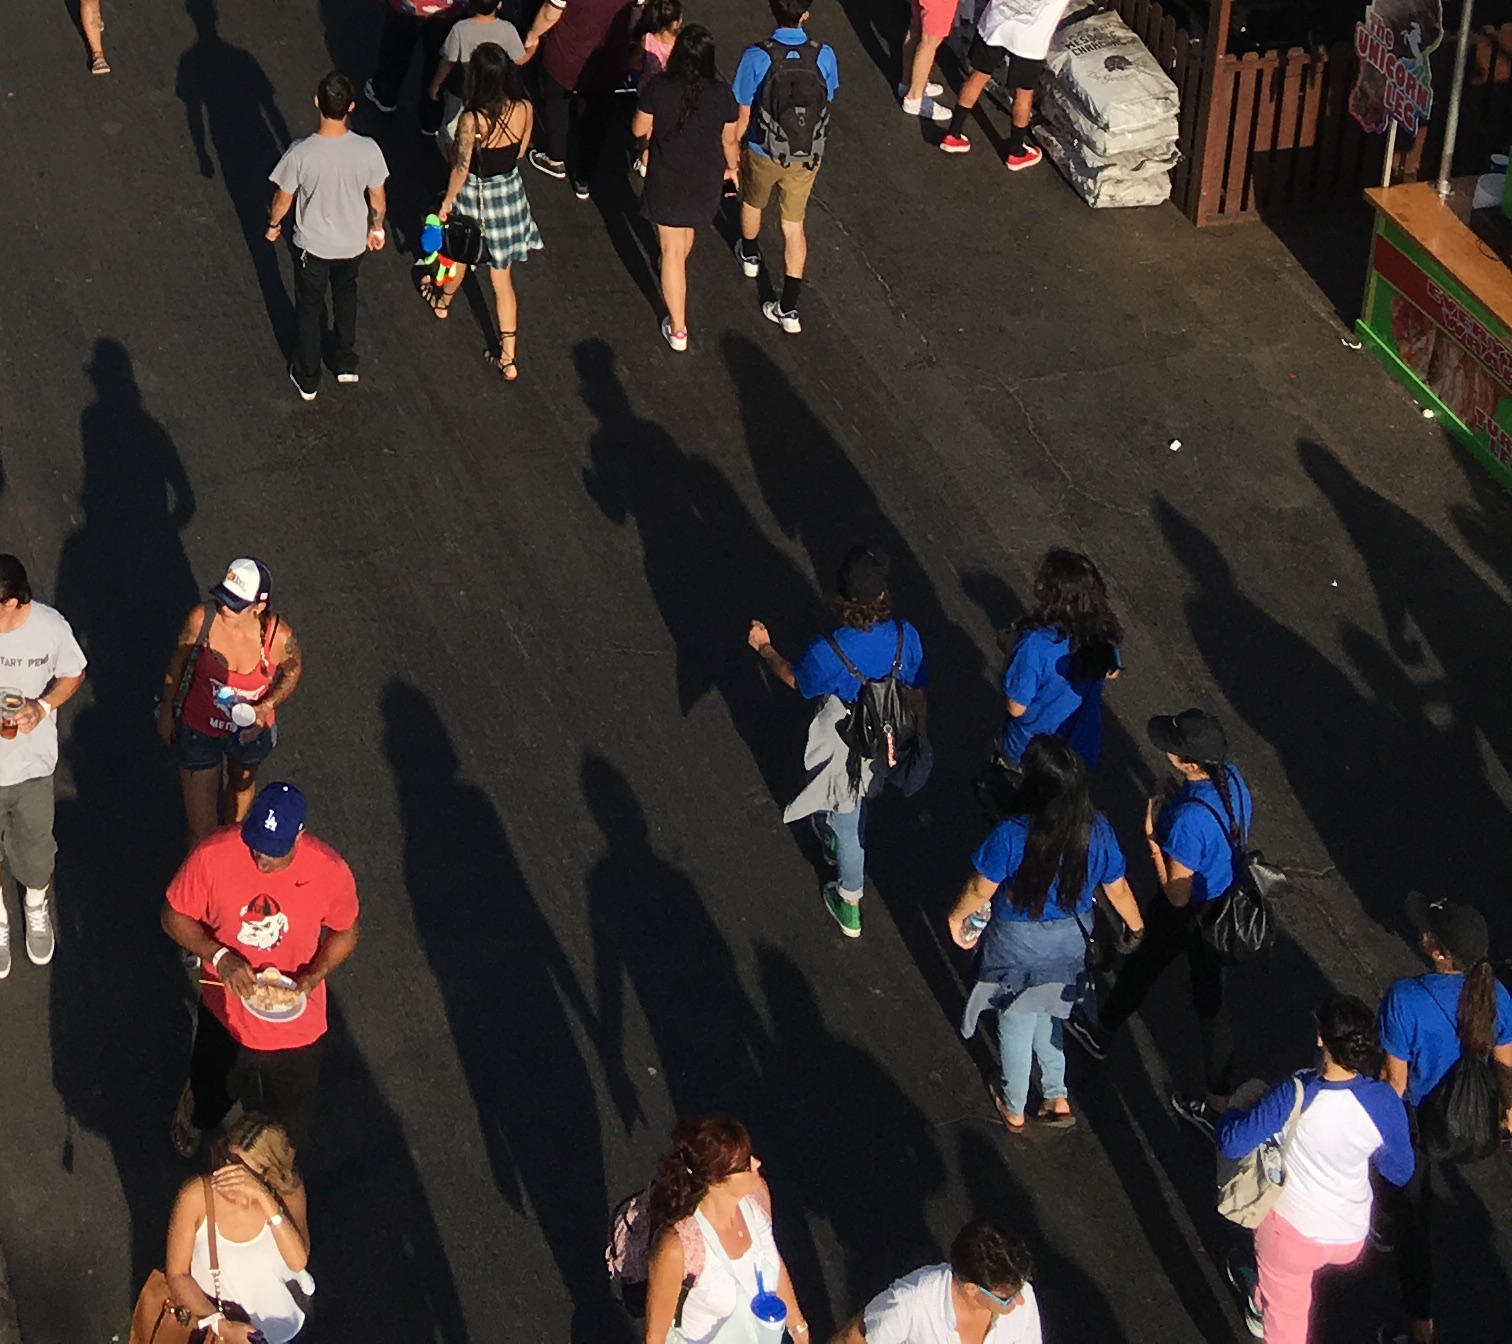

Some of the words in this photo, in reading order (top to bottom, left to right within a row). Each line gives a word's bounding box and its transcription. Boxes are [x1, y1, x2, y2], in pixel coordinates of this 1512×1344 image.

[1369, 11, 1395, 50] The
[1356, 26, 1430, 116] UNICORN
[1383, 78, 1419, 133] LEG
[264, 808, 278, 832] LA
